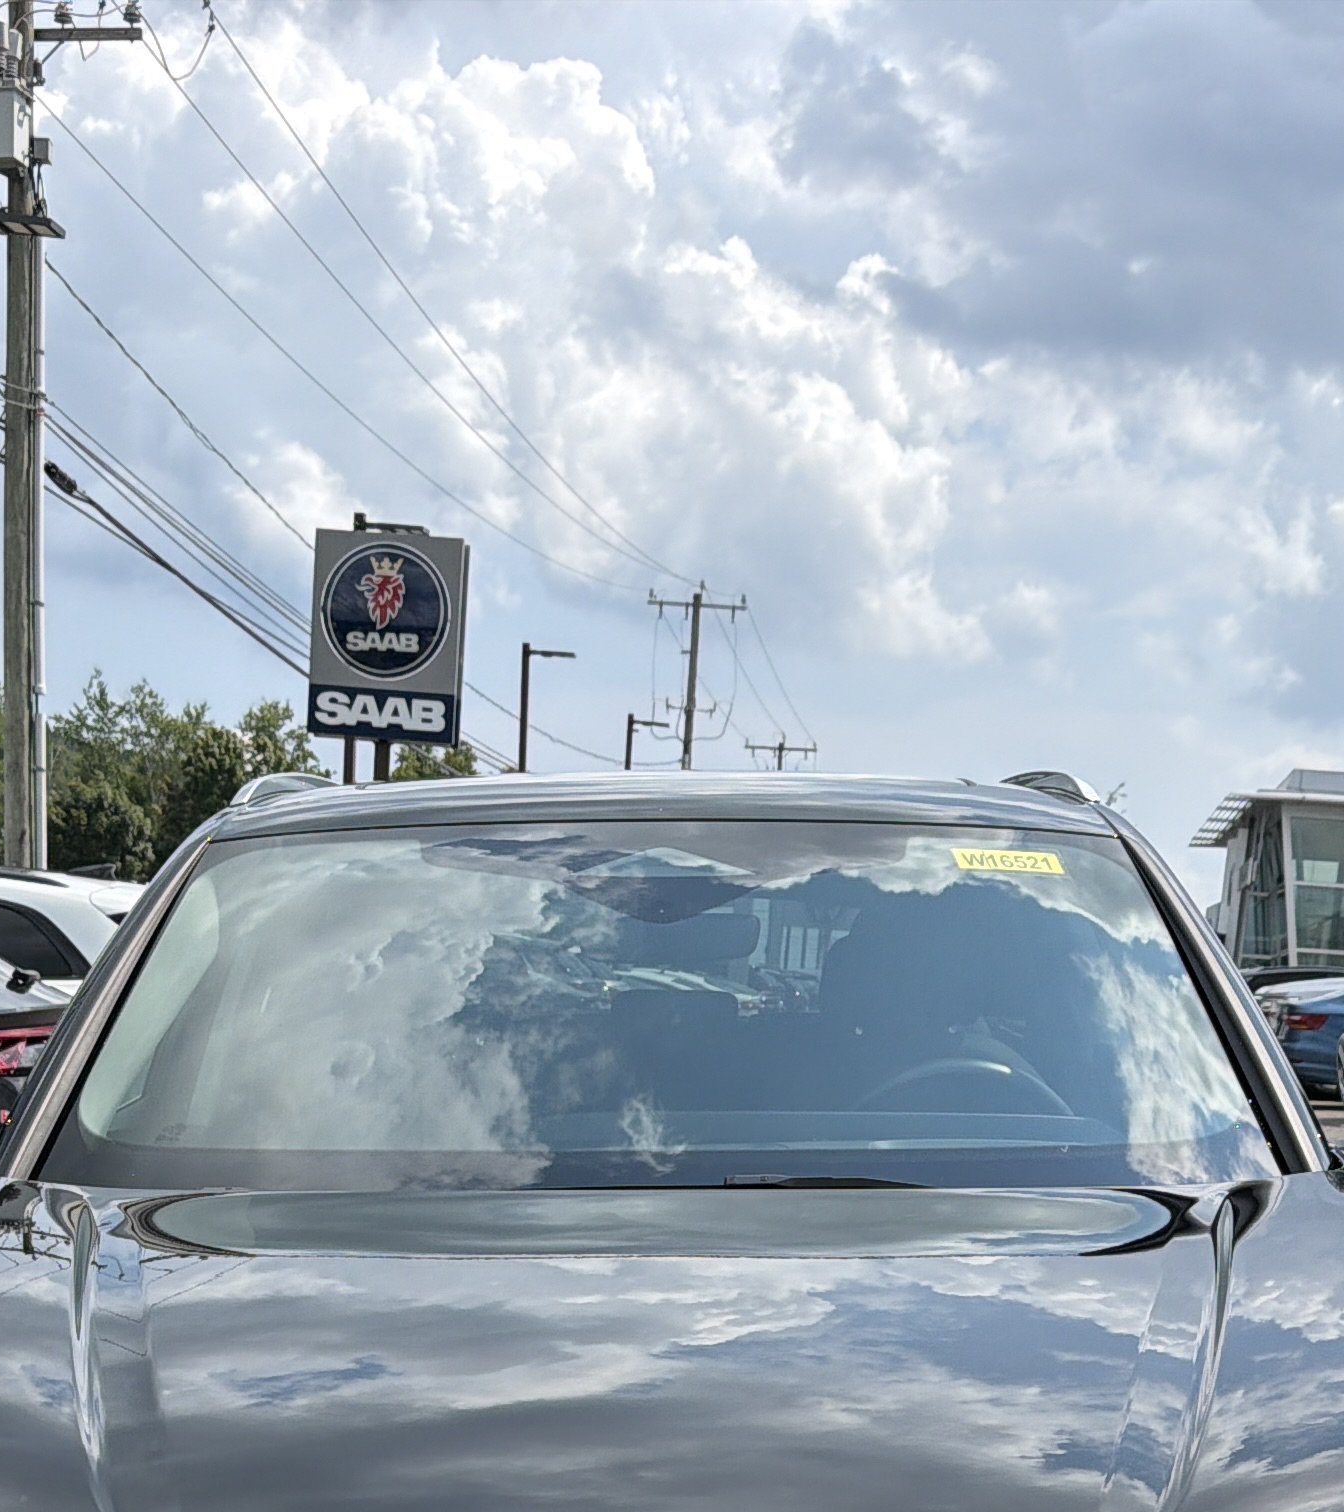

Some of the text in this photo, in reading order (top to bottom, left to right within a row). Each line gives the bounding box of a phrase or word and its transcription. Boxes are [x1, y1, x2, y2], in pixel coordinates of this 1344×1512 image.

[345, 631, 420, 653] SAAB
[314, 690, 446, 733] SAAB
[961, 852, 1053, 871] W16521
